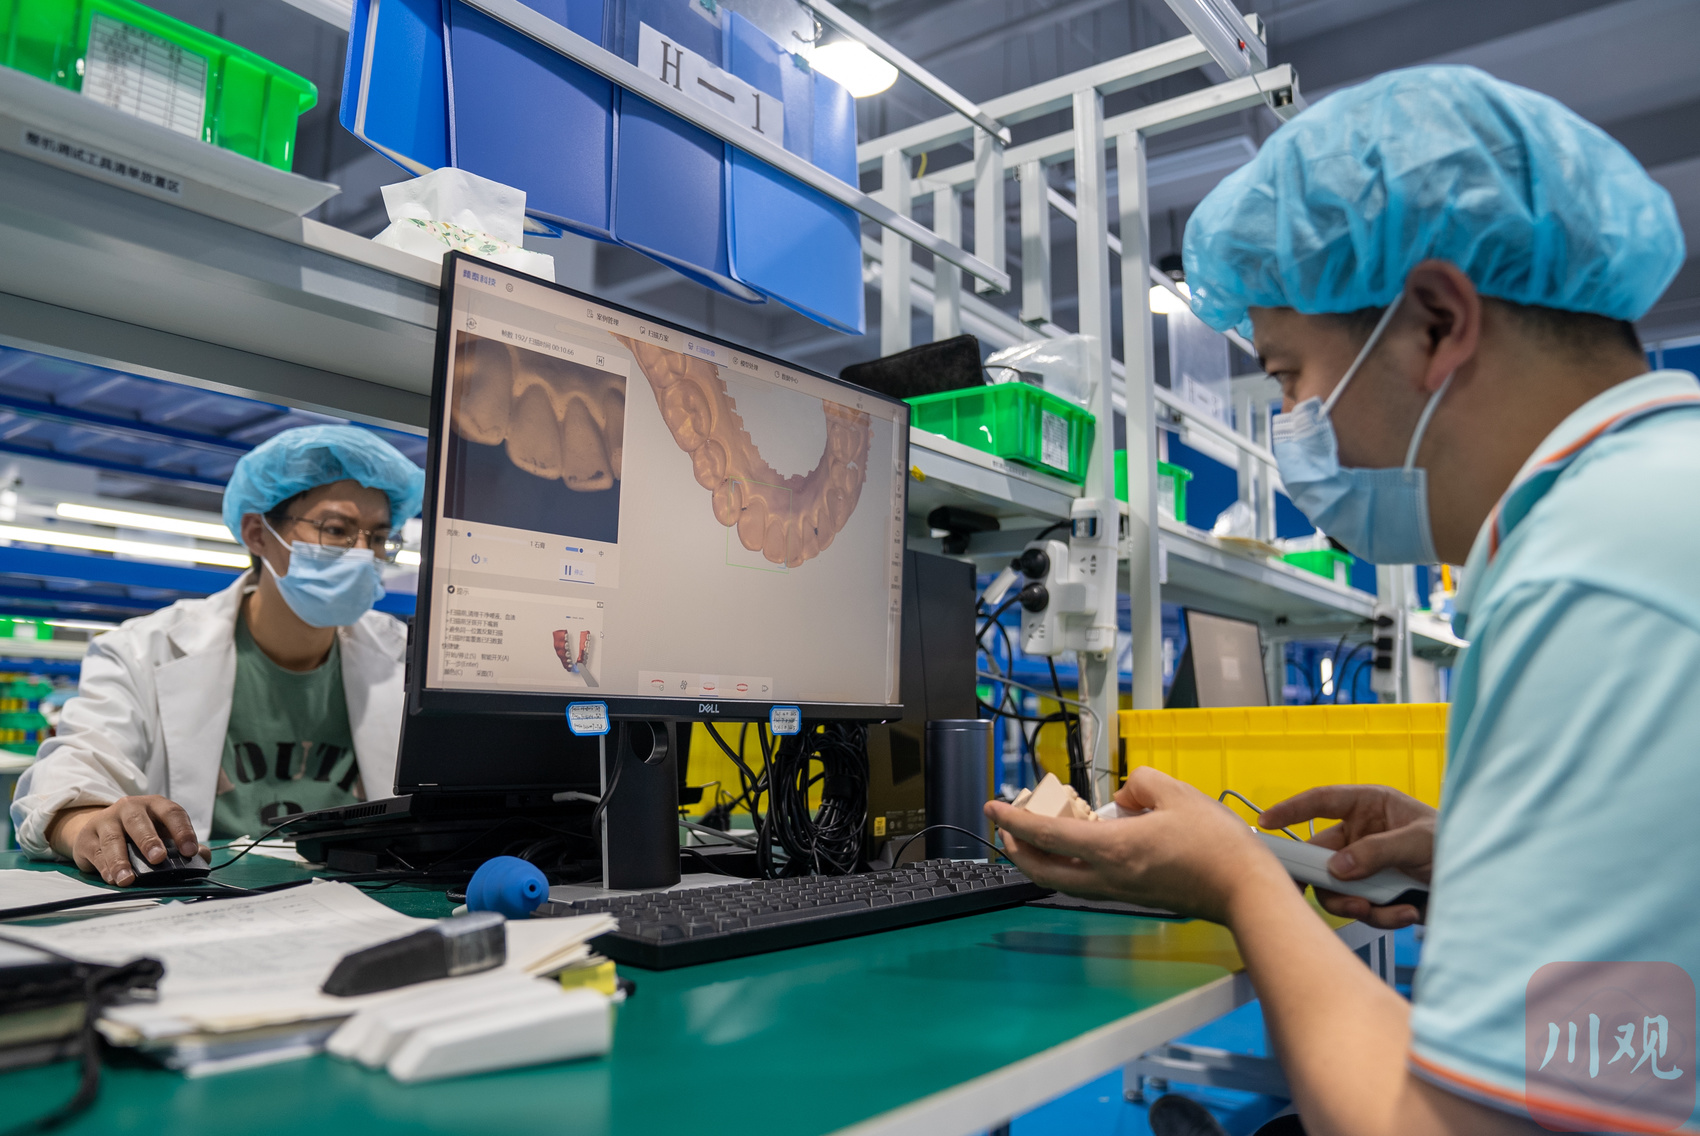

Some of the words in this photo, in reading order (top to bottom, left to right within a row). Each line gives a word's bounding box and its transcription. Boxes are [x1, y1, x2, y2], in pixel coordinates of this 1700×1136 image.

[597, 312, 619, 326] 案例管理
[648, 329, 669, 343] 扫描方案
[528, 338, 551, 350] 扫描时间
[698, 703, 720, 713] DELL
